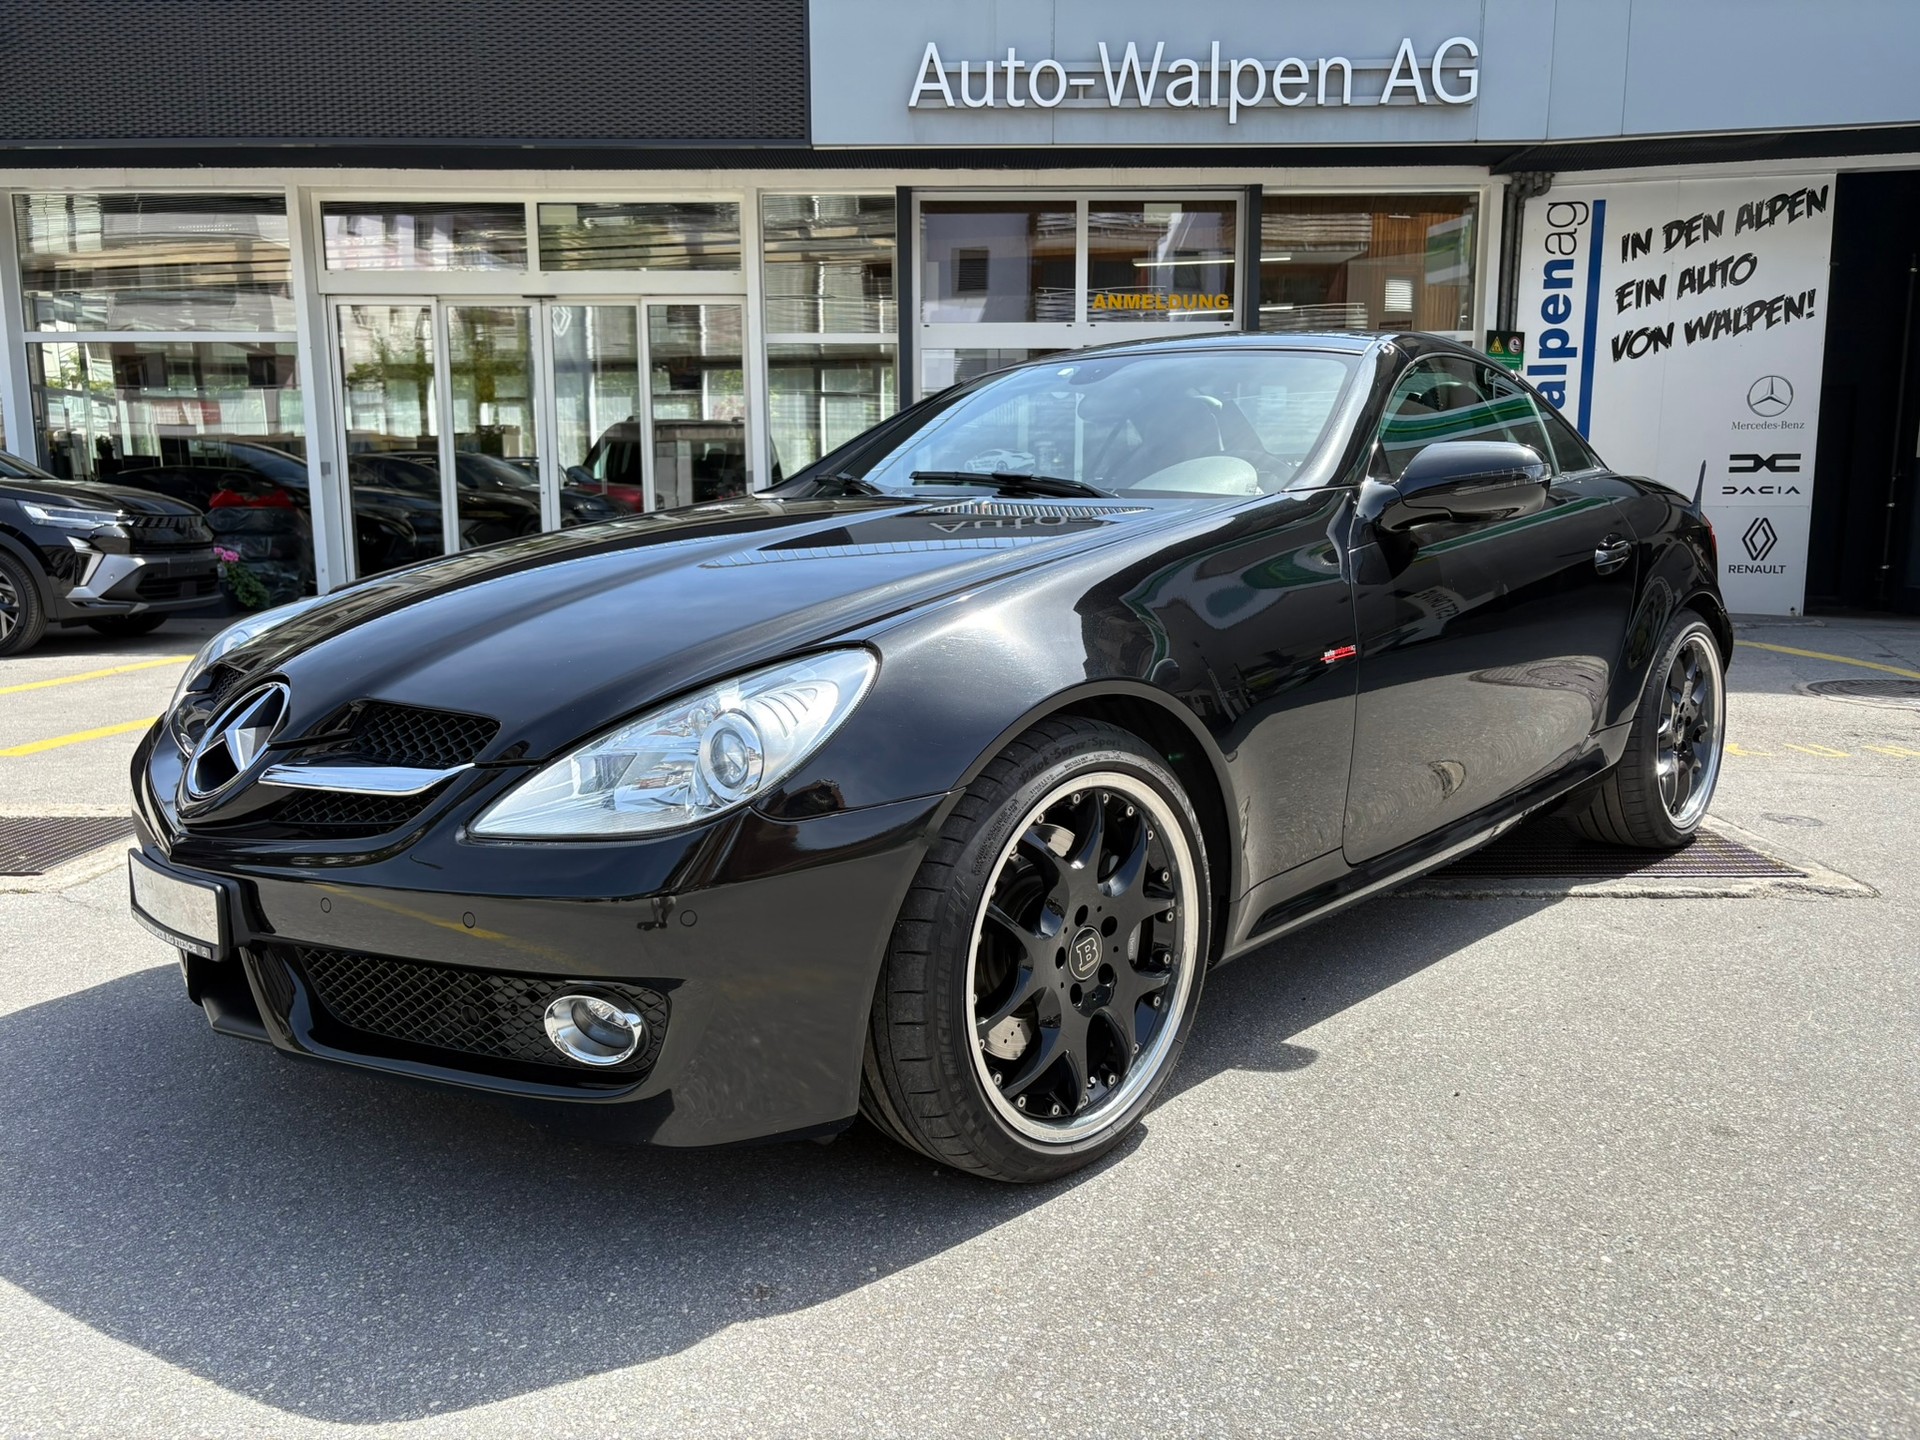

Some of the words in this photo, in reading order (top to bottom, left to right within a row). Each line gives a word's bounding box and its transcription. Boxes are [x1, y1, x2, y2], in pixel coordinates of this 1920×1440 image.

[909, 41, 1352, 124] Auto-Walpen
[1379, 36, 1479, 106] AG
[1621, 227, 1653, 263] IN
[1662, 210, 1725, 254] DEN
[1734, 185, 1829, 237] ALPEN
[1614, 273, 1667, 315] EIN
[1676, 252, 1758, 300] AUTO
[1091, 293, 1230, 311] ANMELDUNG
[1611, 322, 1675, 363] VON
[1683, 288, 1817, 347] WALPEN!
[1731, 420, 1805, 431] Mercedes-Benz
[1721, 485, 1801, 495] DACIA
[1728, 564, 1787, 575] RENAULT
[1052, 740, 1087, 761] Super
[1088, 737, 1121, 748] Sport
[1075, 937, 1099, 972] B
